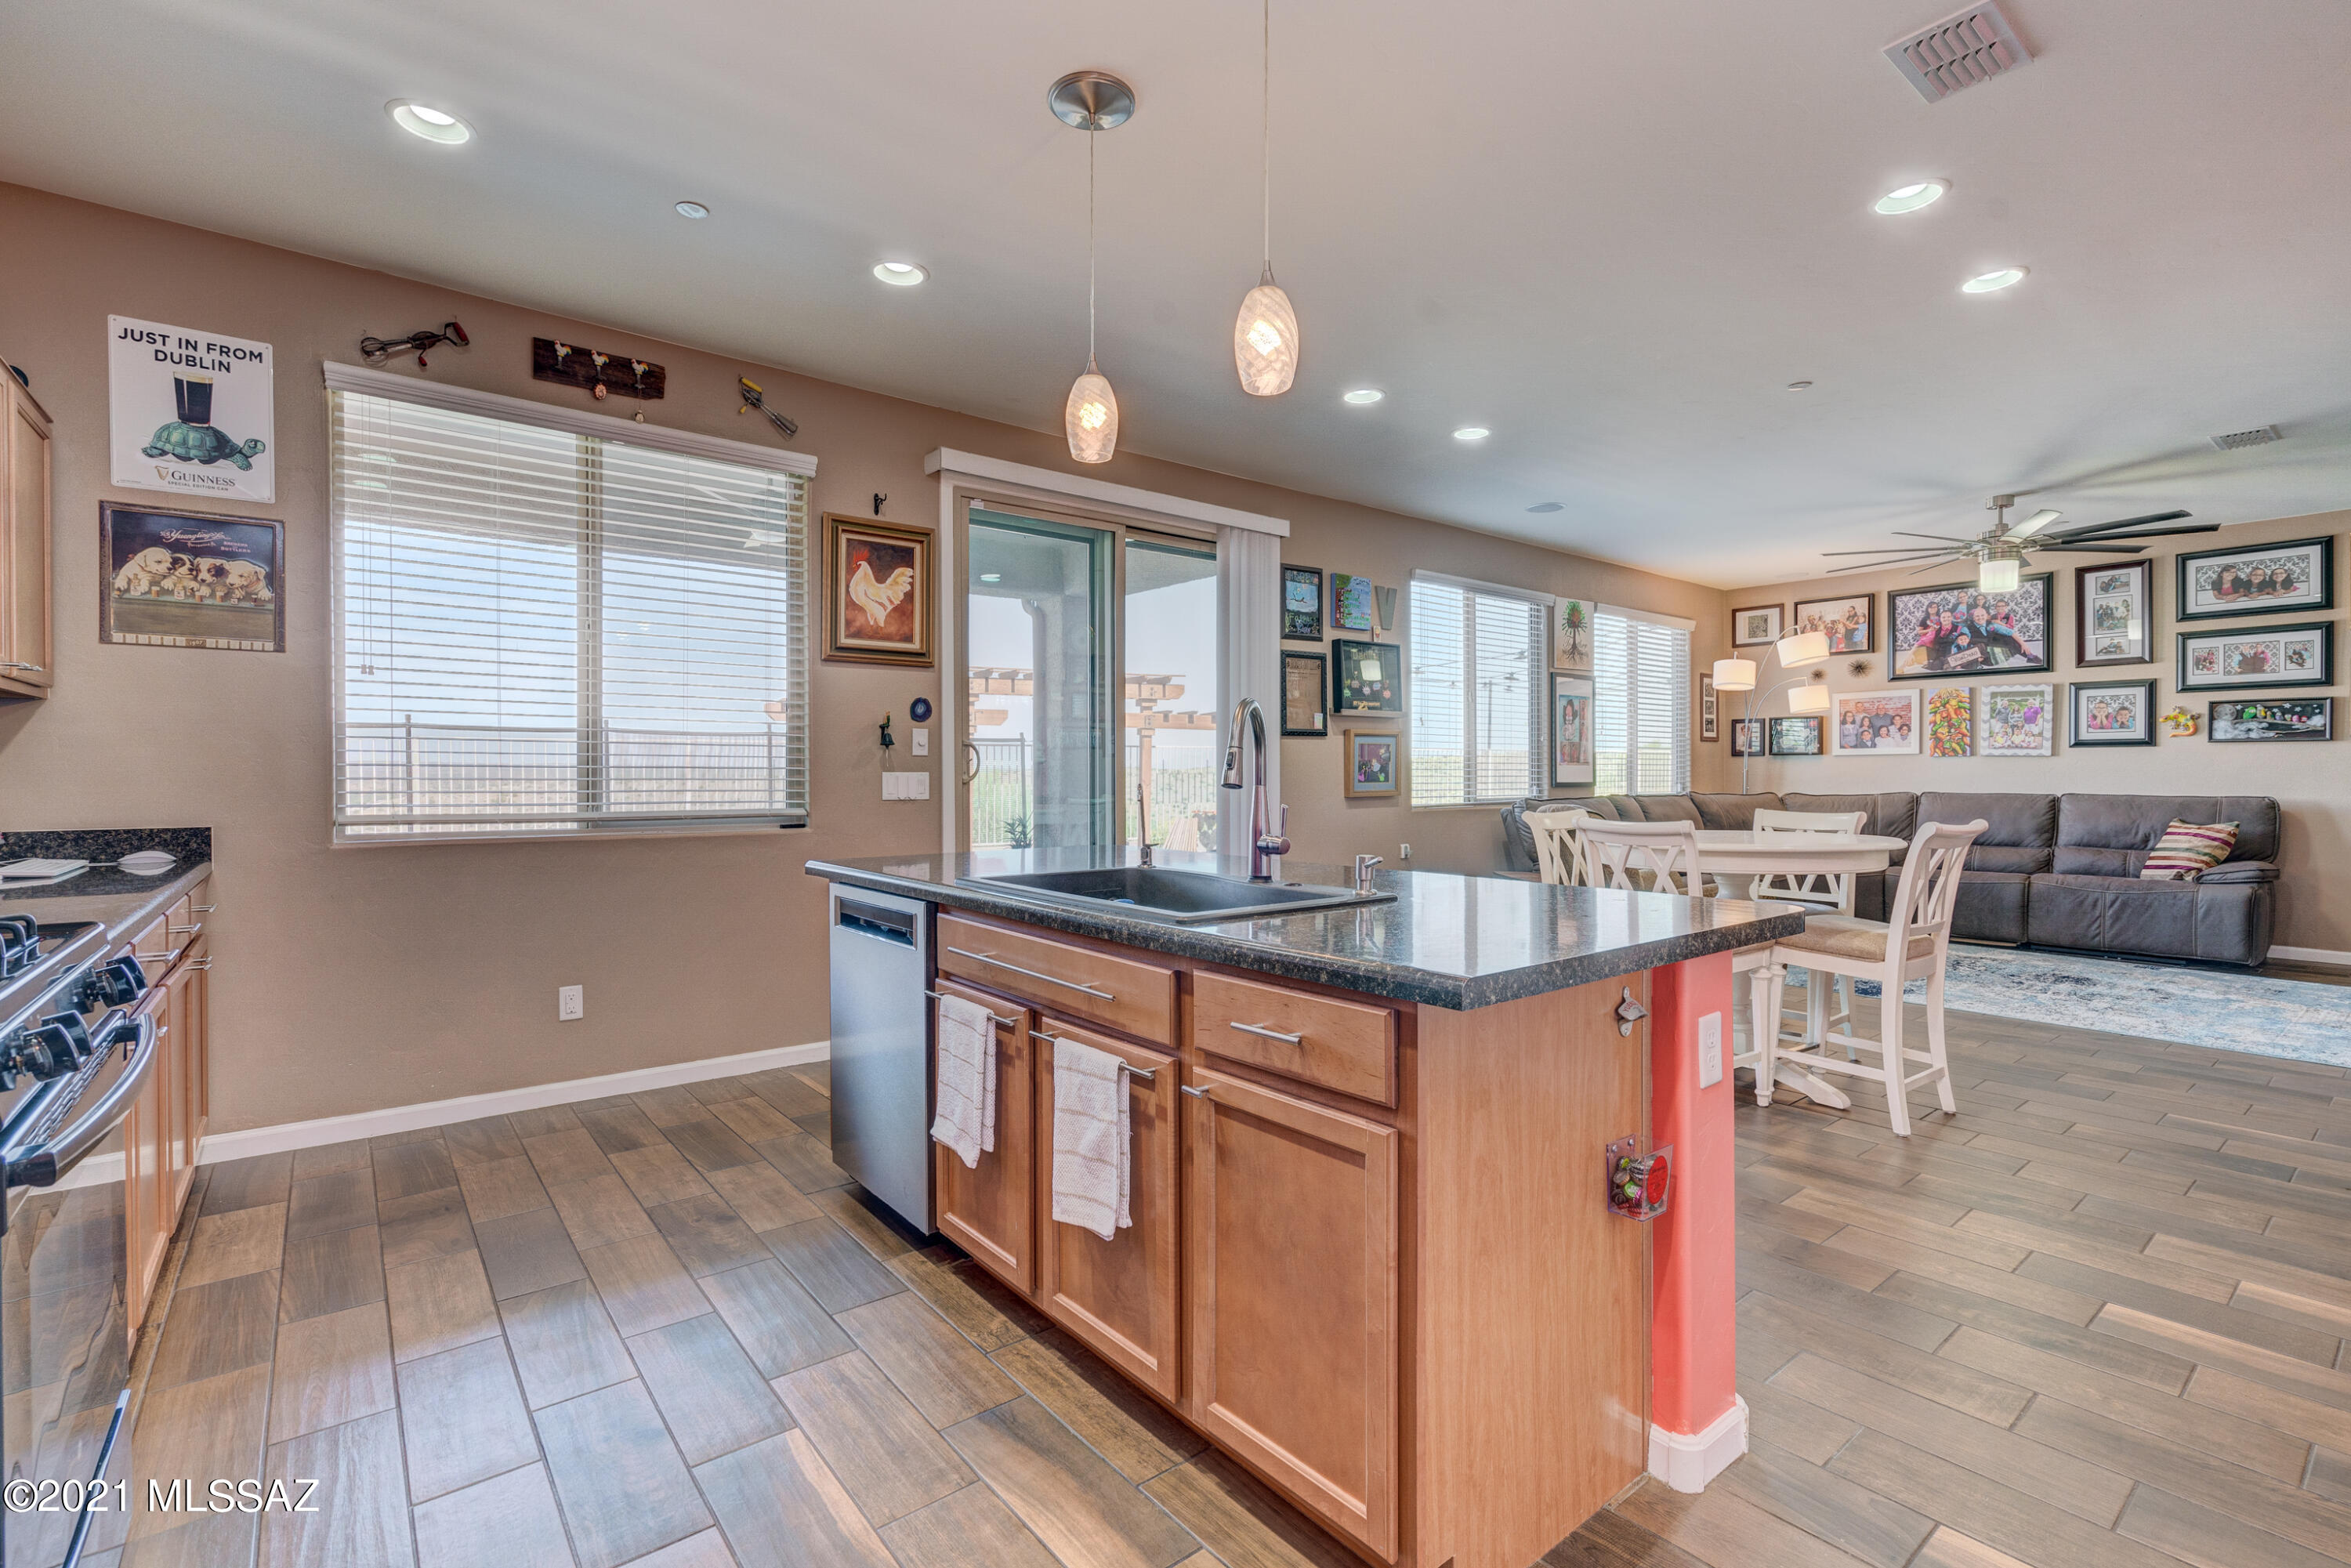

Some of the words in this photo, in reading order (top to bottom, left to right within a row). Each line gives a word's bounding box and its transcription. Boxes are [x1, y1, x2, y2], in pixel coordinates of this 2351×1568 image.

[118, 328, 170, 346] JUST
[178, 337, 198, 352] IN
[206, 342, 263, 364] FROM
[154, 349, 231, 374] DUBLIN
